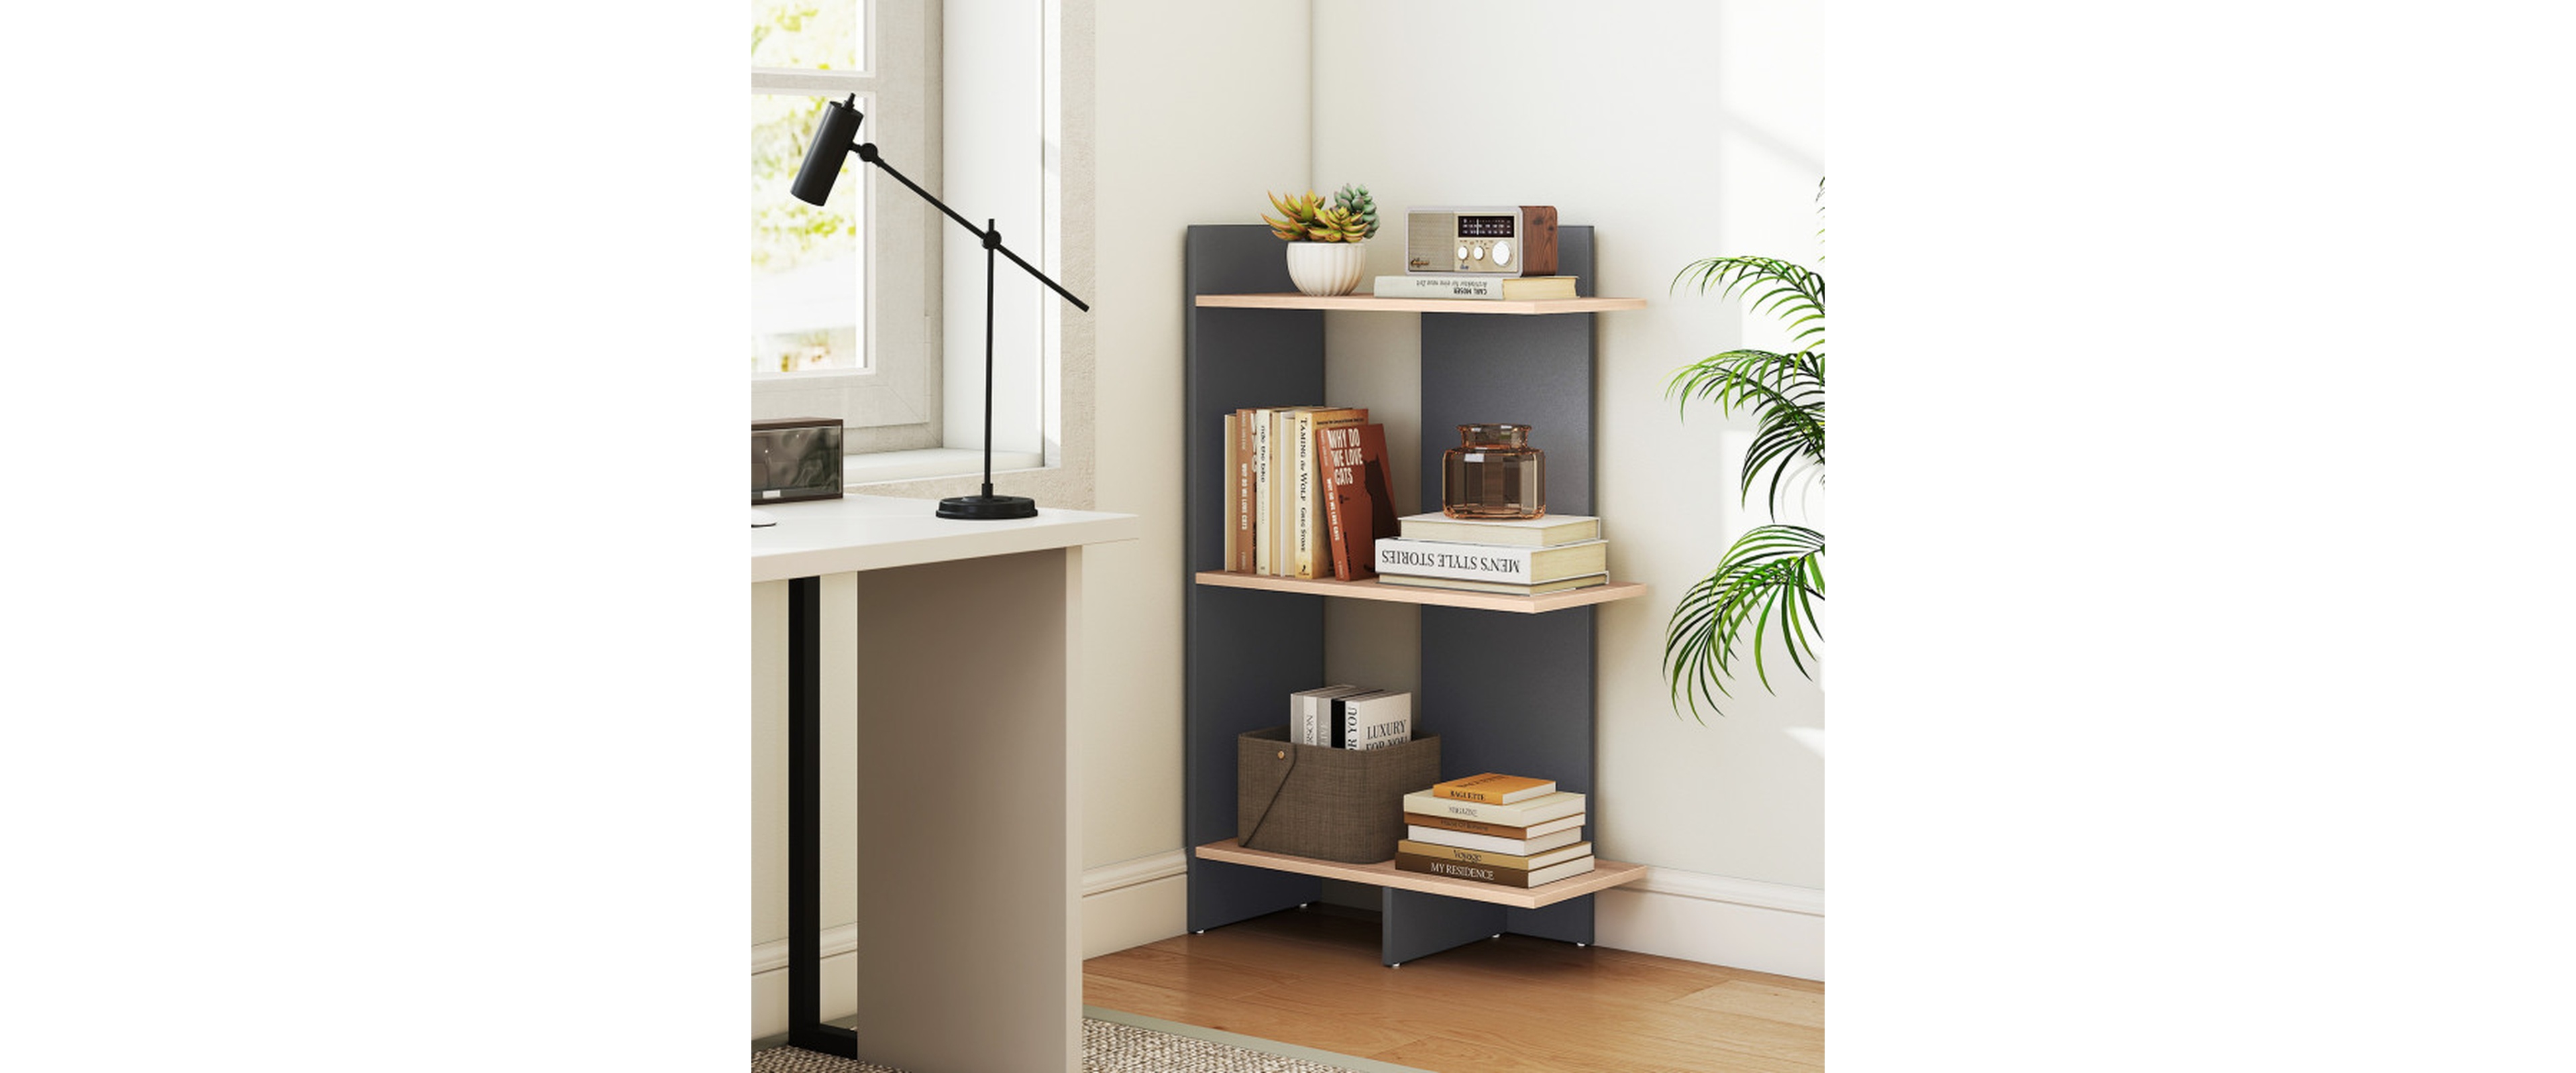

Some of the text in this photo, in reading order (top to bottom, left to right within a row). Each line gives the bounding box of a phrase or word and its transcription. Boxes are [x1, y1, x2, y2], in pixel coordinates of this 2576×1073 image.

[1327, 429, 1347, 449] WHY
[1348, 428, 1360, 447] DO
[1330, 449, 1344, 467] WE
[1344, 447, 1363, 465] LOVE
[1334, 467, 1353, 486] CATS
[1381, 549, 1521, 573] MEN'S STYLE STORIES
[1348, 706, 1357, 733] YOU
[1367, 719, 1407, 740] LUXURY
[1453, 849, 1481, 863] Voyage
[1430, 862, 1495, 881] MY RESIDENCE
